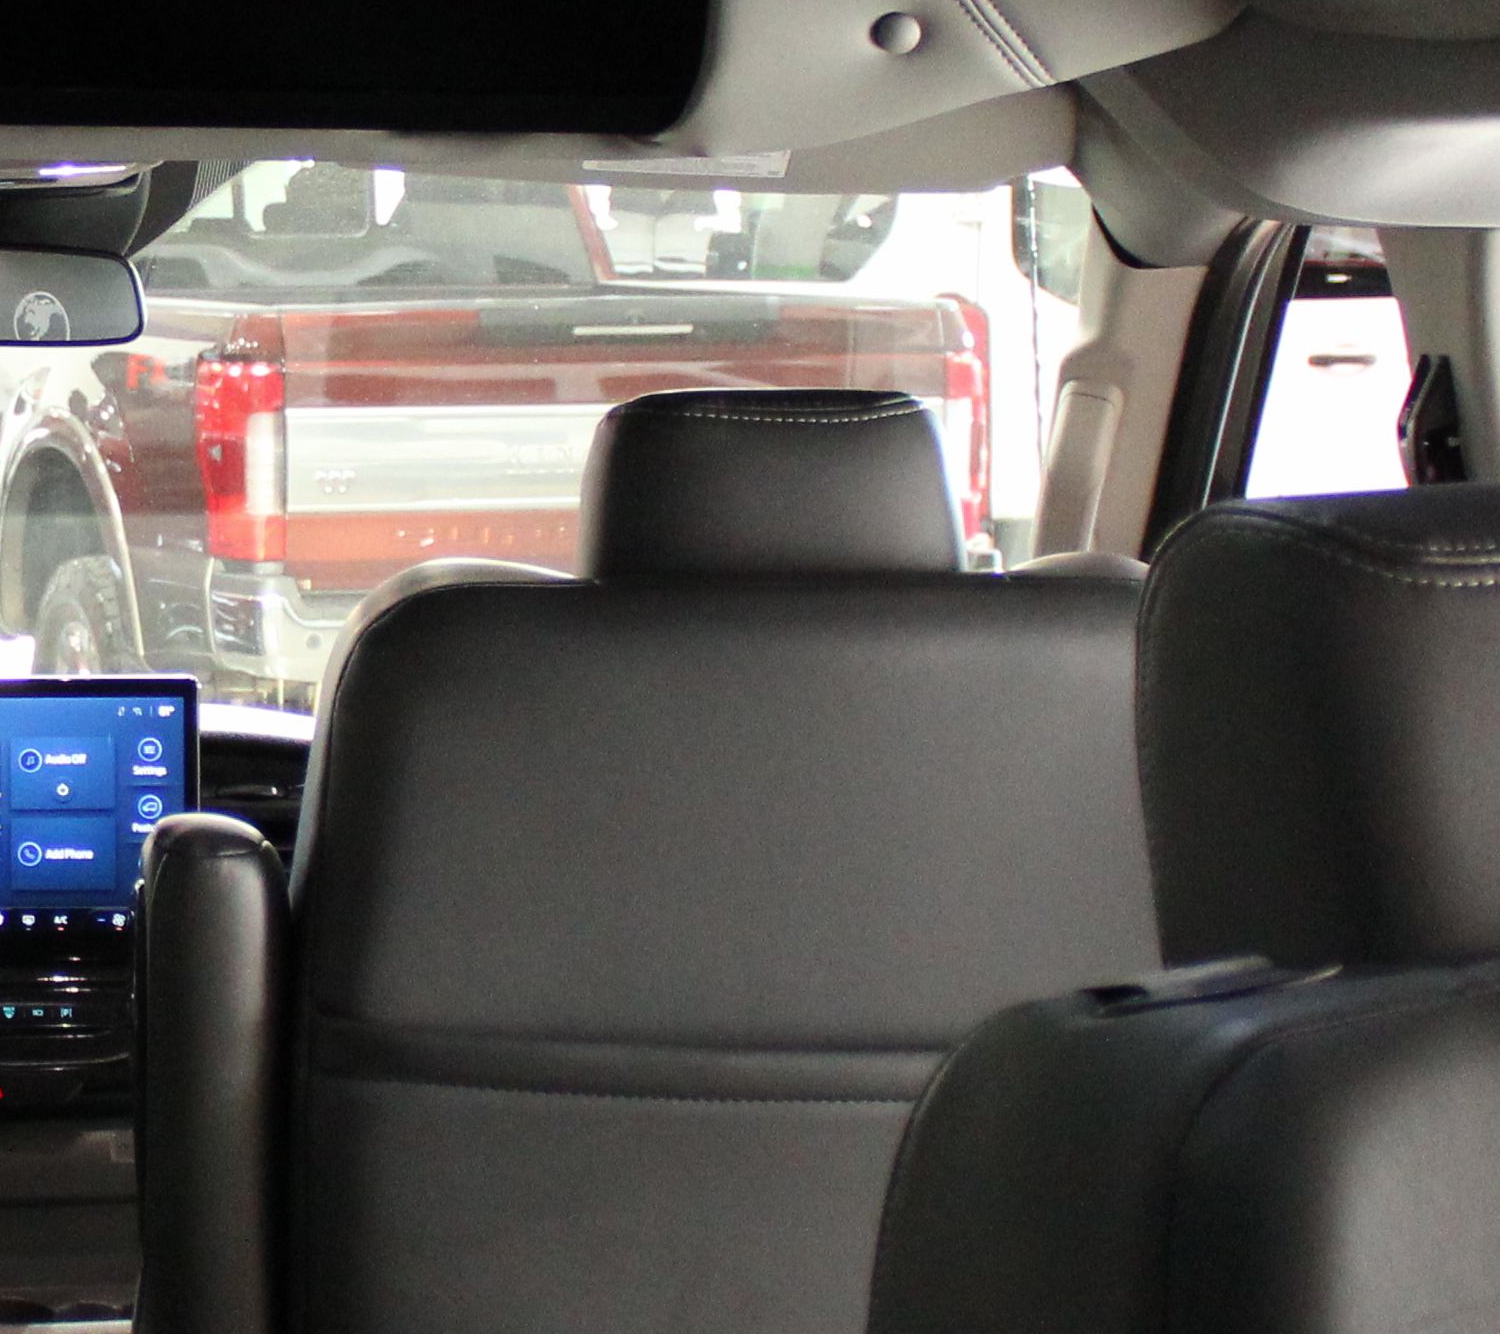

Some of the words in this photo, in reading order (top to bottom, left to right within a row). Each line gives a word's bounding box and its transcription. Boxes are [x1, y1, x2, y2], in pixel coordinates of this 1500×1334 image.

[45, 753, 71, 765] Audio
[71, 753, 88, 765] Off
[132, 765, 168, 777] Settings
[45, 848, 65, 860] Add
[65, 848, 95, 860] Phone
[53, 915, 68, 925] A/C
